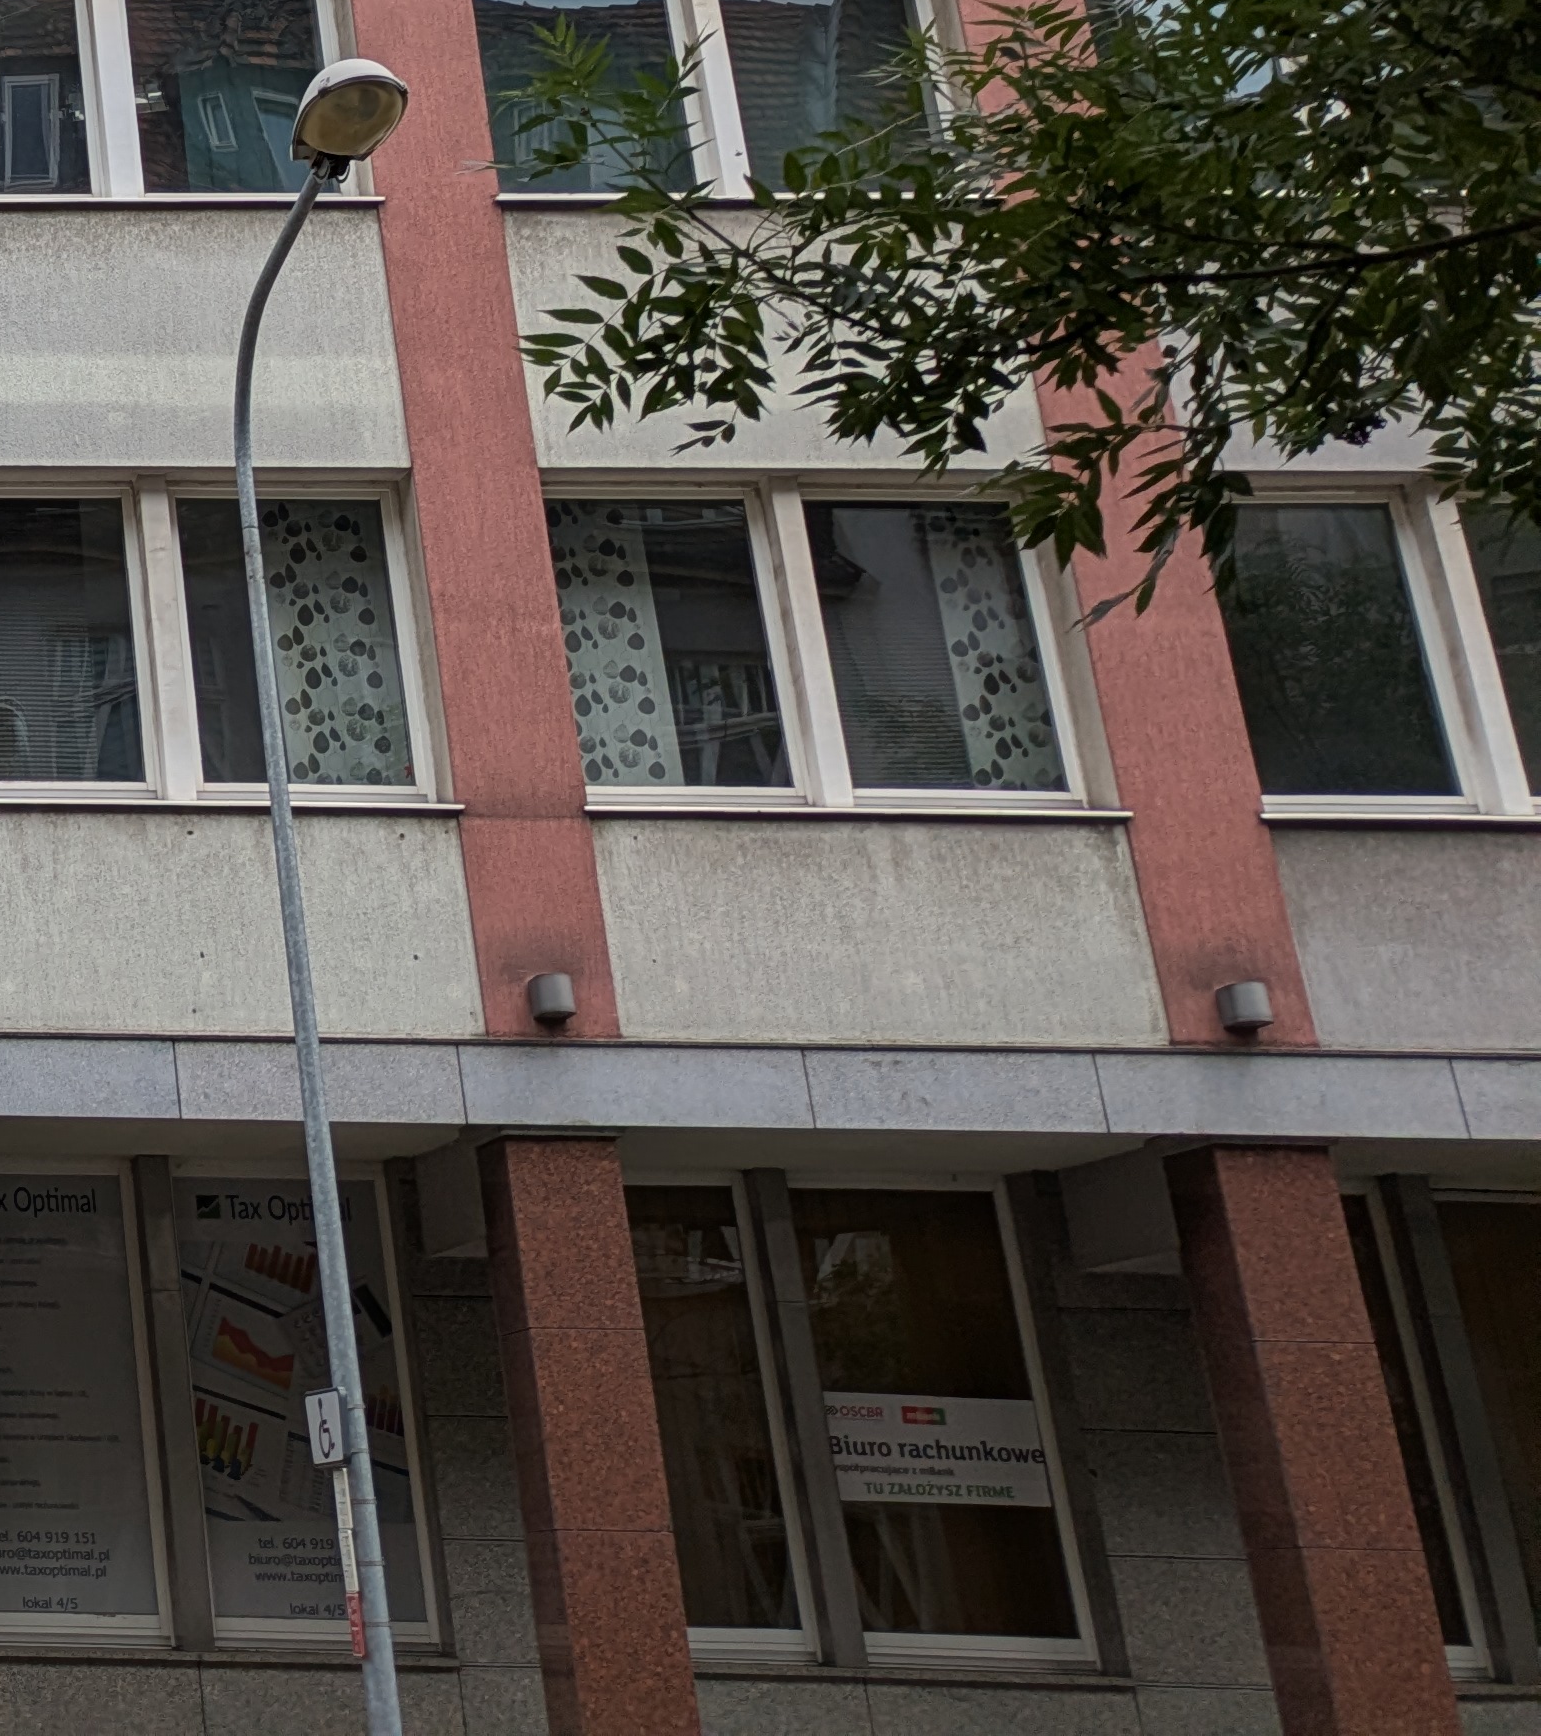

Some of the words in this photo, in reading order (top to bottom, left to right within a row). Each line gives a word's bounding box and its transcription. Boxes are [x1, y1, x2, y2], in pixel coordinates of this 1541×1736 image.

[13, 1186, 97, 1218] Optimal
[225, 1194, 263, 1220] Tax
[829, 1434, 892, 1457] Biuro
[897, 1439, 1046, 1464] rachunkowe
[864, 1482, 884, 1495] TU
[889, 1480, 962, 1497] ZAŁOŻYSZ
[967, 1484, 1015, 1499] FIRMĘ
[17, 1530, 41, 1543] 604
[45, 1531, 69, 1544] 919
[75, 1532, 96, 1544] 151
[258, 1537, 279, 1549] tel.
[283, 1537, 306, 1550] 604
[310, 1538, 335, 1550] 919
[22, 1596, 53, 1609] lokal
[56, 1597, 78, 1612] 4/5
[289, 1603, 319, 1616] lokal
[323, 1604, 346, 1617] 4/5
